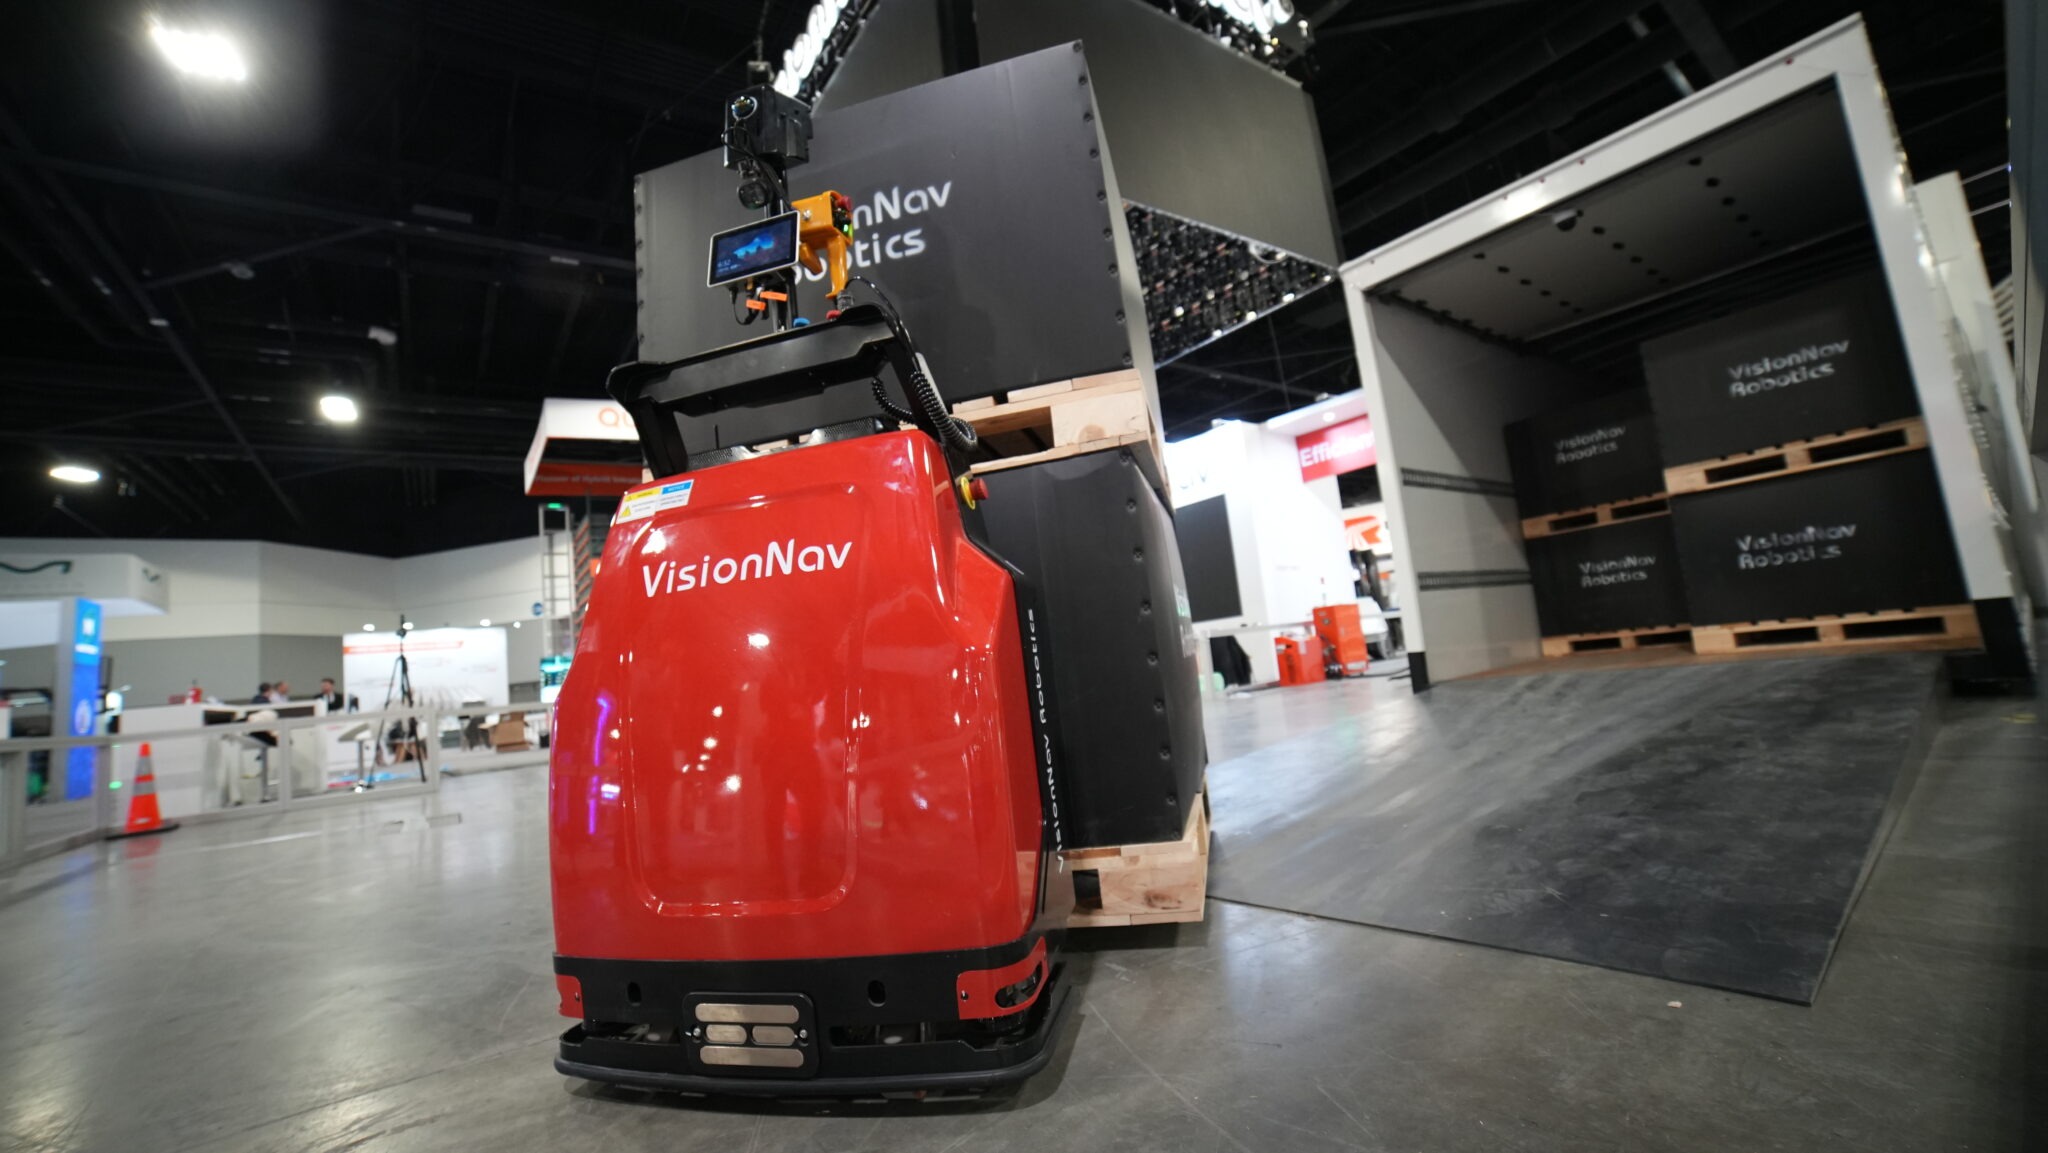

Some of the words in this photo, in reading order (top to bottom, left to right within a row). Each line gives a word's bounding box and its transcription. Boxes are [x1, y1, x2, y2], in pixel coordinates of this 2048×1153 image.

[1728, 340, 1849, 379] VisionNav
[1730, 362, 1835, 397] Robotics
[642, 538, 852, 598] VisionNav
[1028, 608, 1047, 724] Robotics
[1043, 734, 1064, 874] VisionNav
